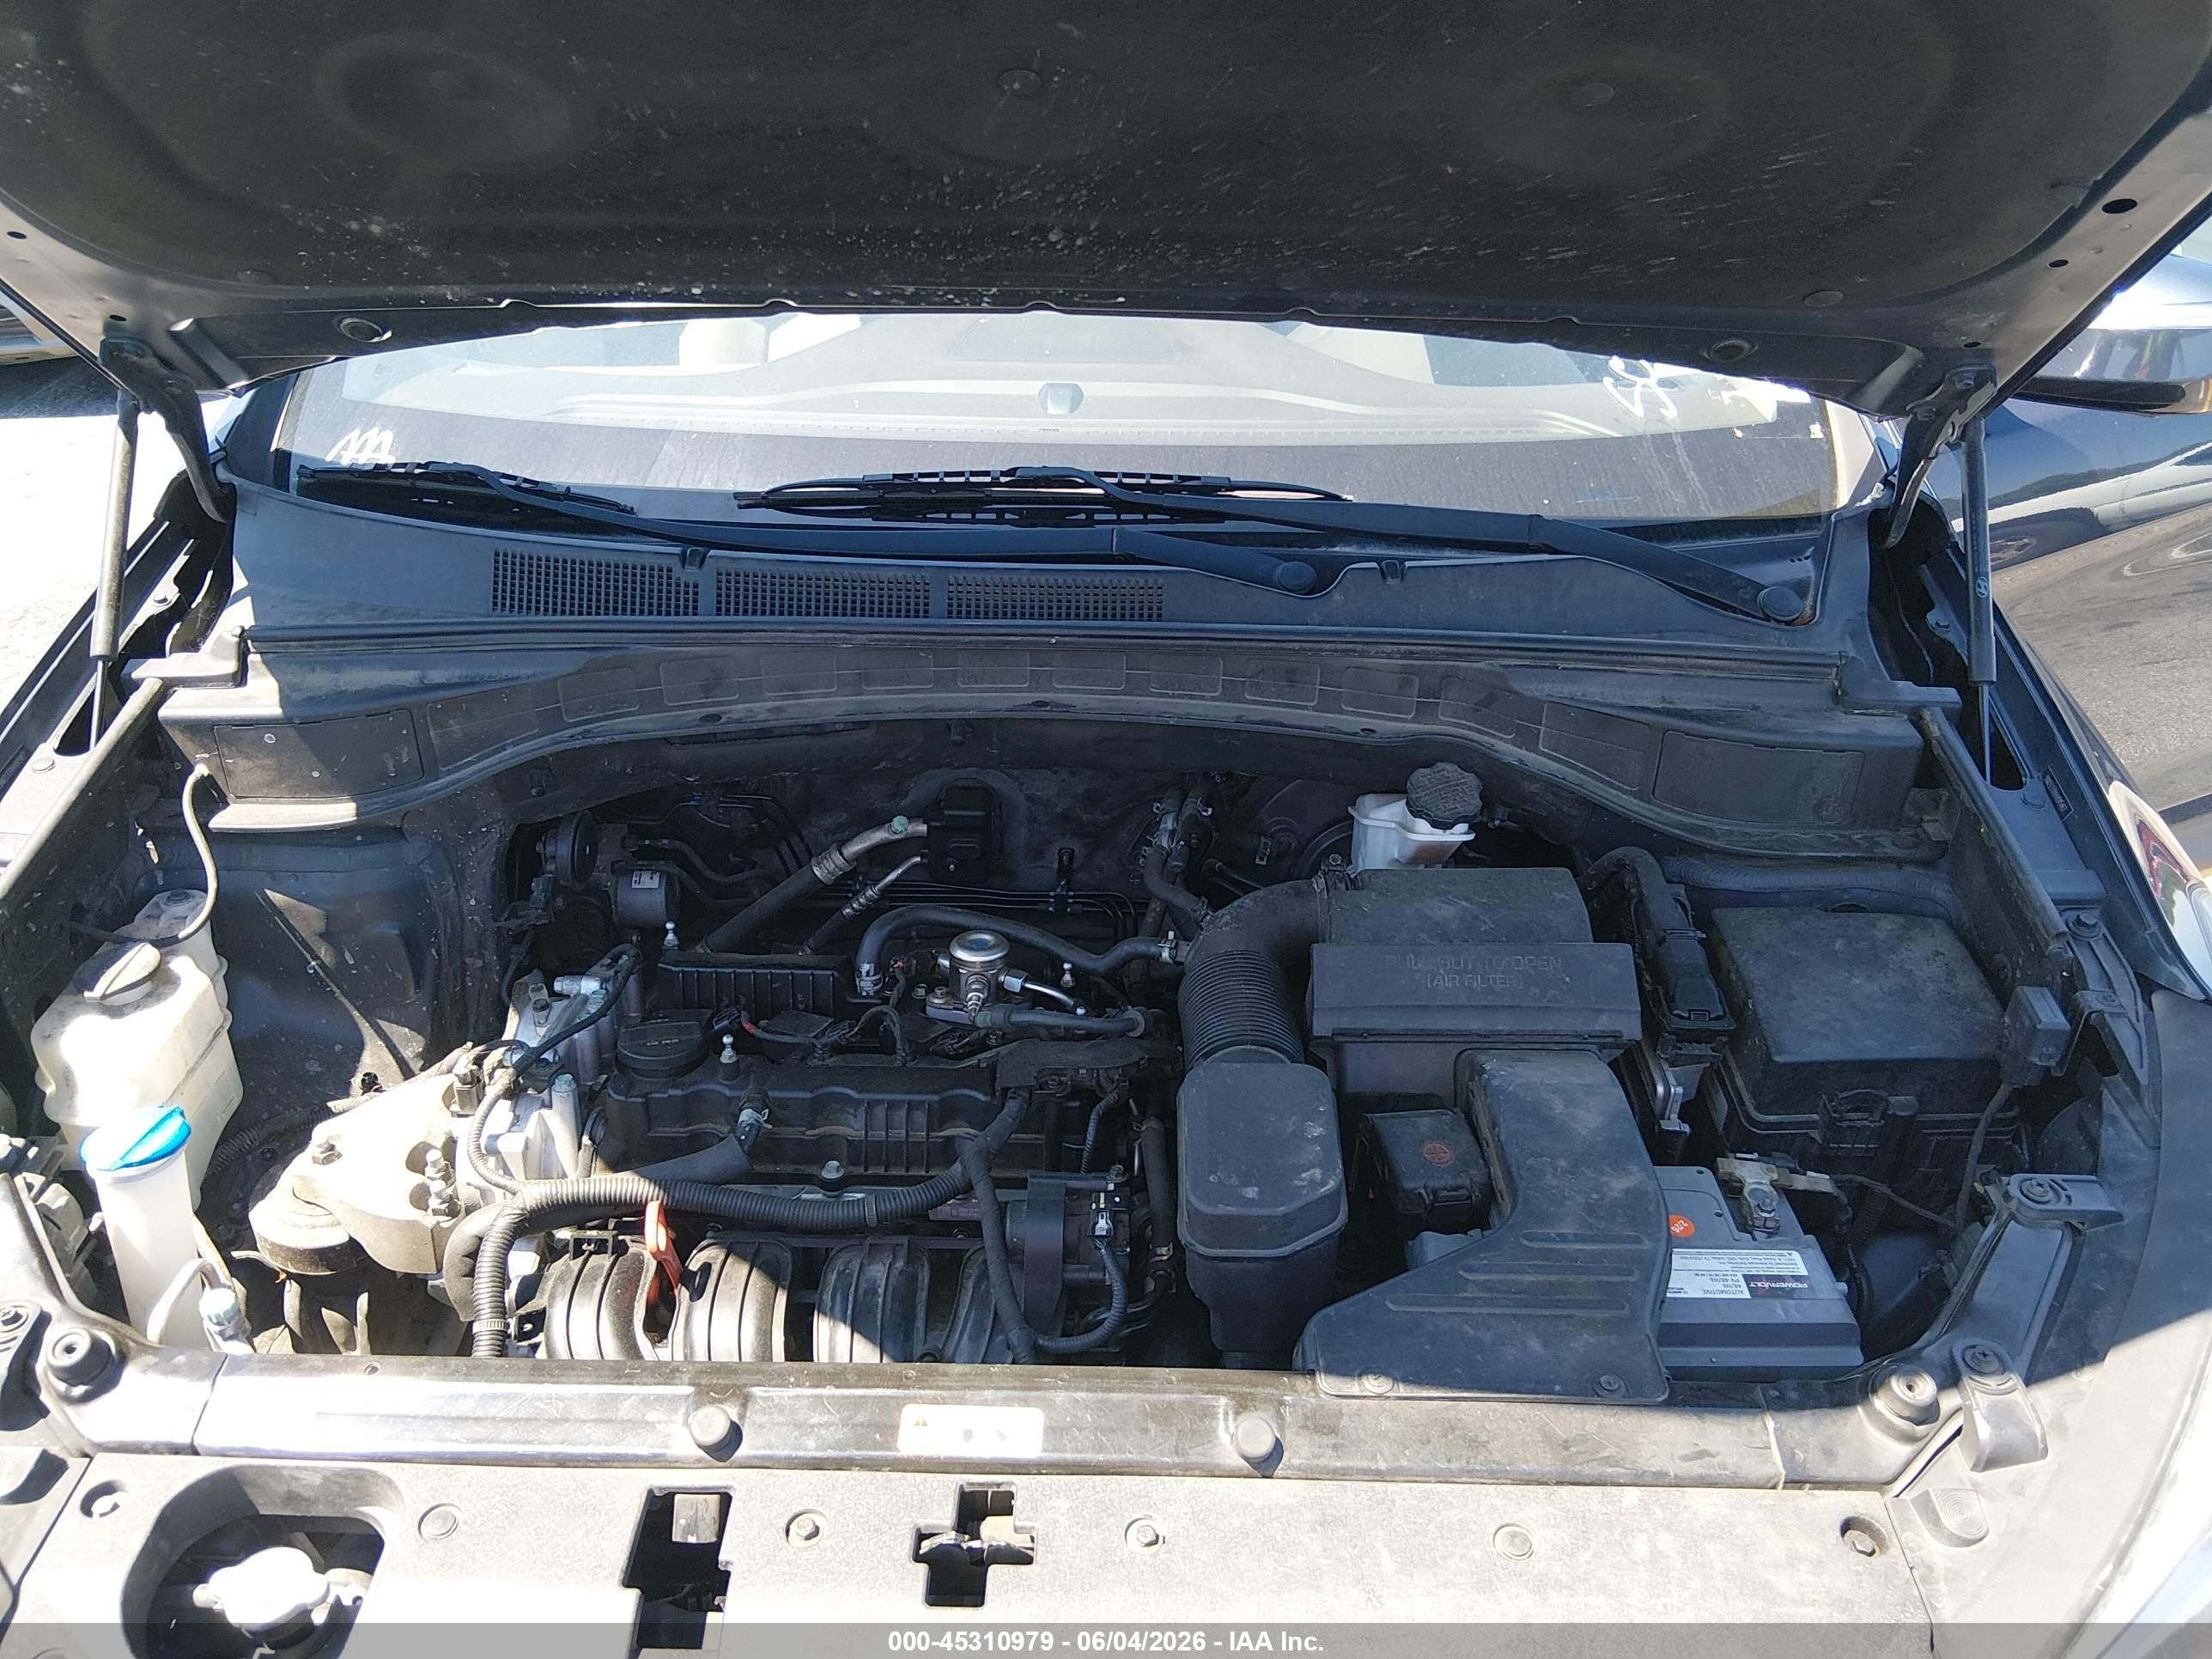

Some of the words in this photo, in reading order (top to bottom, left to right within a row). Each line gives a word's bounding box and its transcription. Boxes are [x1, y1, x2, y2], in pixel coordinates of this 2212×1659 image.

[1438, 954, 1473, 969] OUT
[1511, 955, 1562, 971] OPEN
[1749, 1281, 1808, 1290] POWERVOLT
